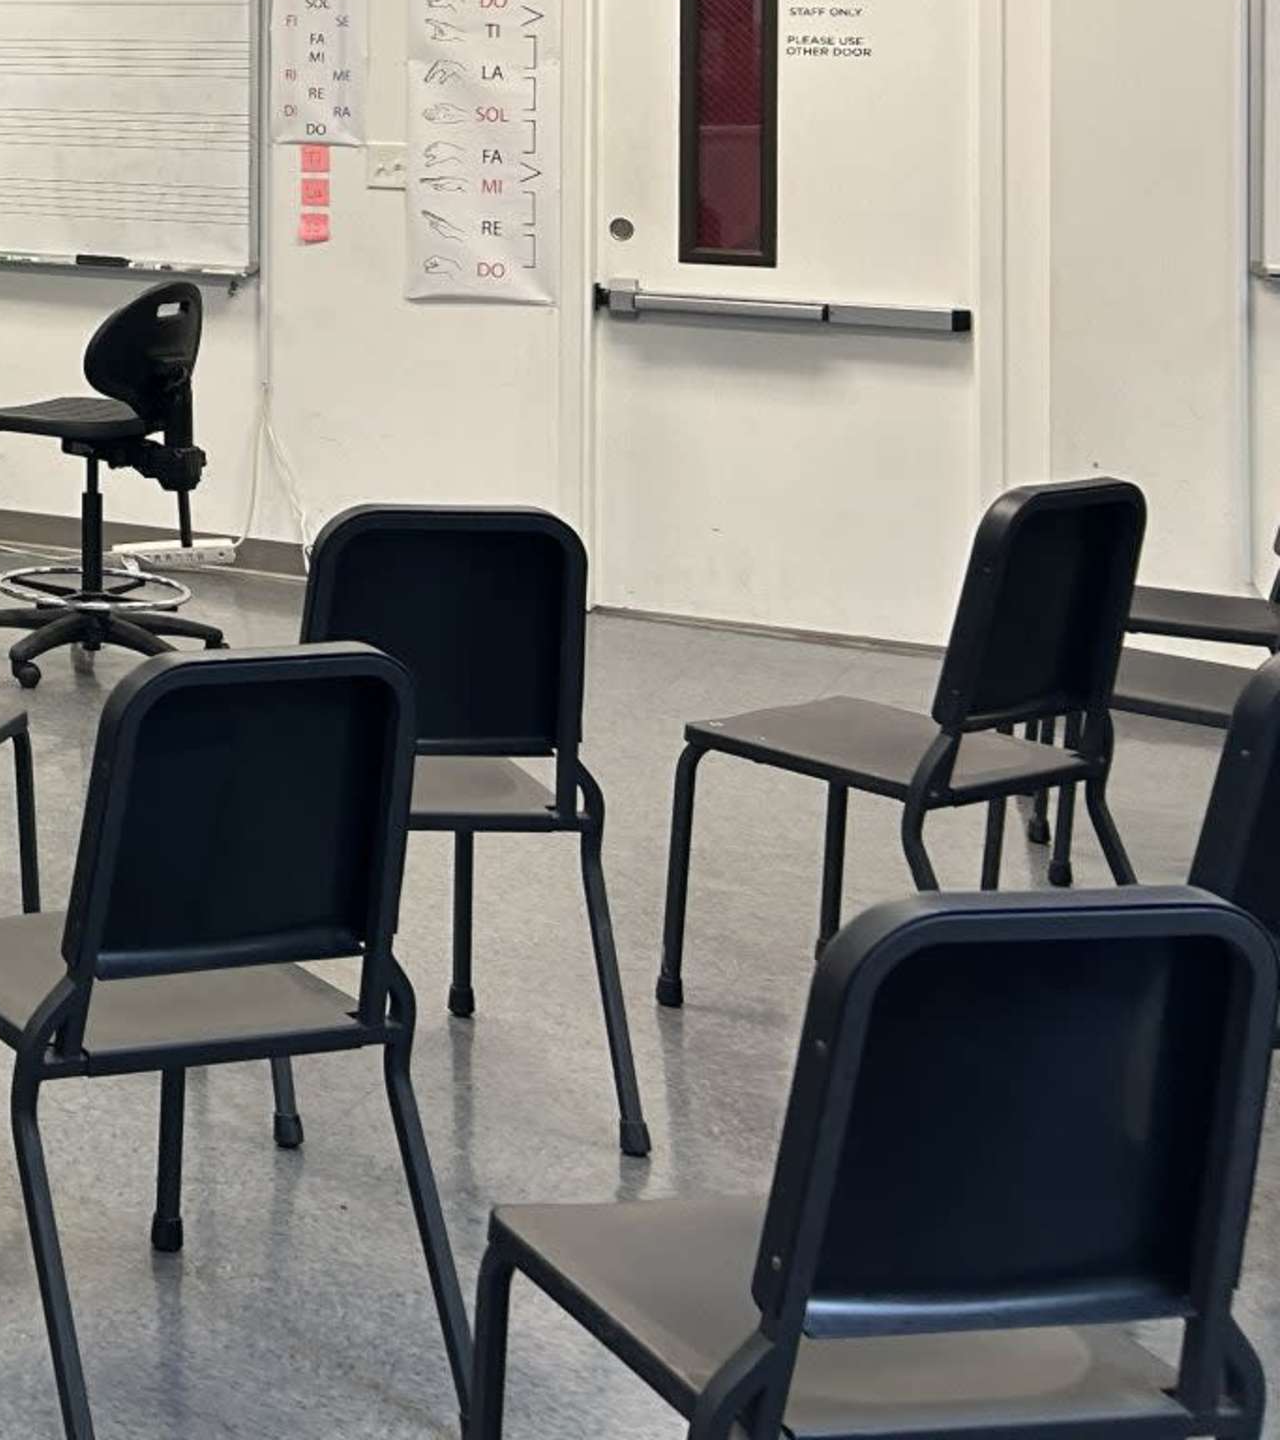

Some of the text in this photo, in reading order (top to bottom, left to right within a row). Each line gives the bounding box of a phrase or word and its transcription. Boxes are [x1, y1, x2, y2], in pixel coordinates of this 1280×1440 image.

[789, 6, 863, 17] STAFF ONLY
[484, 23, 501, 38] TI
[309, 33, 325, 45] FA
[786, 34, 865, 46] PLEASE USE
[308, 51, 325, 63] MI
[786, 46, 873, 58] OTHER DOOR
[332, 69, 351, 82] ME
[481, 65, 504, 80] LA
[308, 87, 325, 99] RE
[333, 106, 351, 118] RA
[475, 106, 510, 123] SOL
[305, 123, 327, 136] DO
[482, 148, 503, 164] FA
[482, 179, 503, 195] MI
[482, 220, 503, 237] RE
[477, 261, 505, 279] DO
